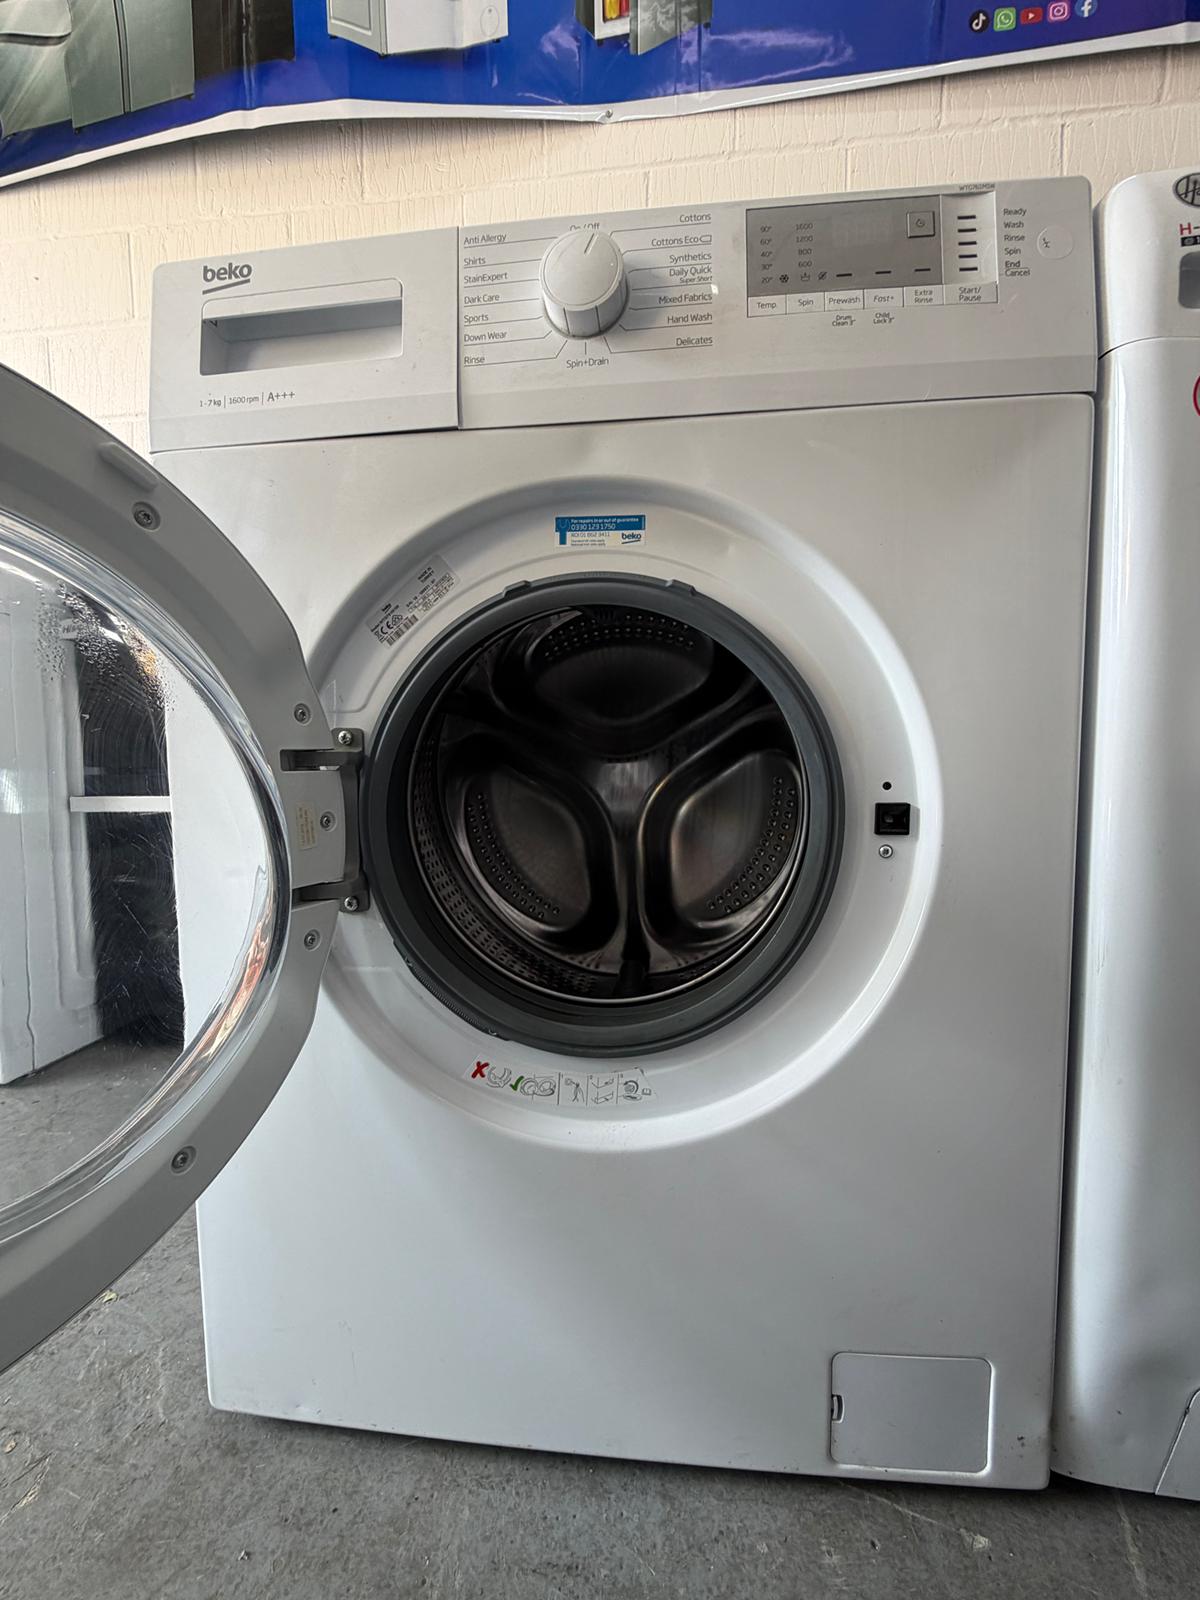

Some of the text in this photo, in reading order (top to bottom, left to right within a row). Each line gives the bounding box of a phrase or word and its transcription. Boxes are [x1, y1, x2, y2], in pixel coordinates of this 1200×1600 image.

[680, 212, 712, 223] Cottons
[1003, 208, 1027, 217] Ready
[1003, 220, 1025, 229] Wash
[463, 233, 507, 245] Anti Allergy
[651, 235, 699, 247] Cottons Eco
[1003, 233, 1026, 242] Rinse
[1004, 246, 1022, 256] Spin
[463, 255, 487, 266] Shirts
[669, 251, 712, 264] Synthetics
[1004, 260, 1021, 268] End
[202, 262, 253, 283] beko
[669, 265, 712, 278] Daily Quick
[1004, 268, 1031, 277] Cancel
[463, 271, 508, 285] StainExpert
[958, 286, 981, 295] Start/
[464, 293, 500, 304] Dark Care
[658, 292, 713, 304] Mixed Fabrics
[797, 298, 814, 307] Spin
[828, 296, 861, 305] Prewash
[914, 295, 934, 304] Rinse
[958, 294, 982, 302] Pause
[756, 301, 777, 309] Temp
[463, 313, 489, 324] Sports
[667, 312, 713, 324] Hand Wash
[873, 317, 888, 325] Lock
[463, 330, 507, 342] Down Wear
[675, 335, 713, 346] Delicates
[463, 355, 485, 365] Rinse
[566, 357, 610, 369] Spin+Drain
[229, 394, 260, 405] 1600 rpm
[267, 391, 296, 402] A+++
[213, 398, 222, 407] kg
[621, 532, 642, 540] beko
